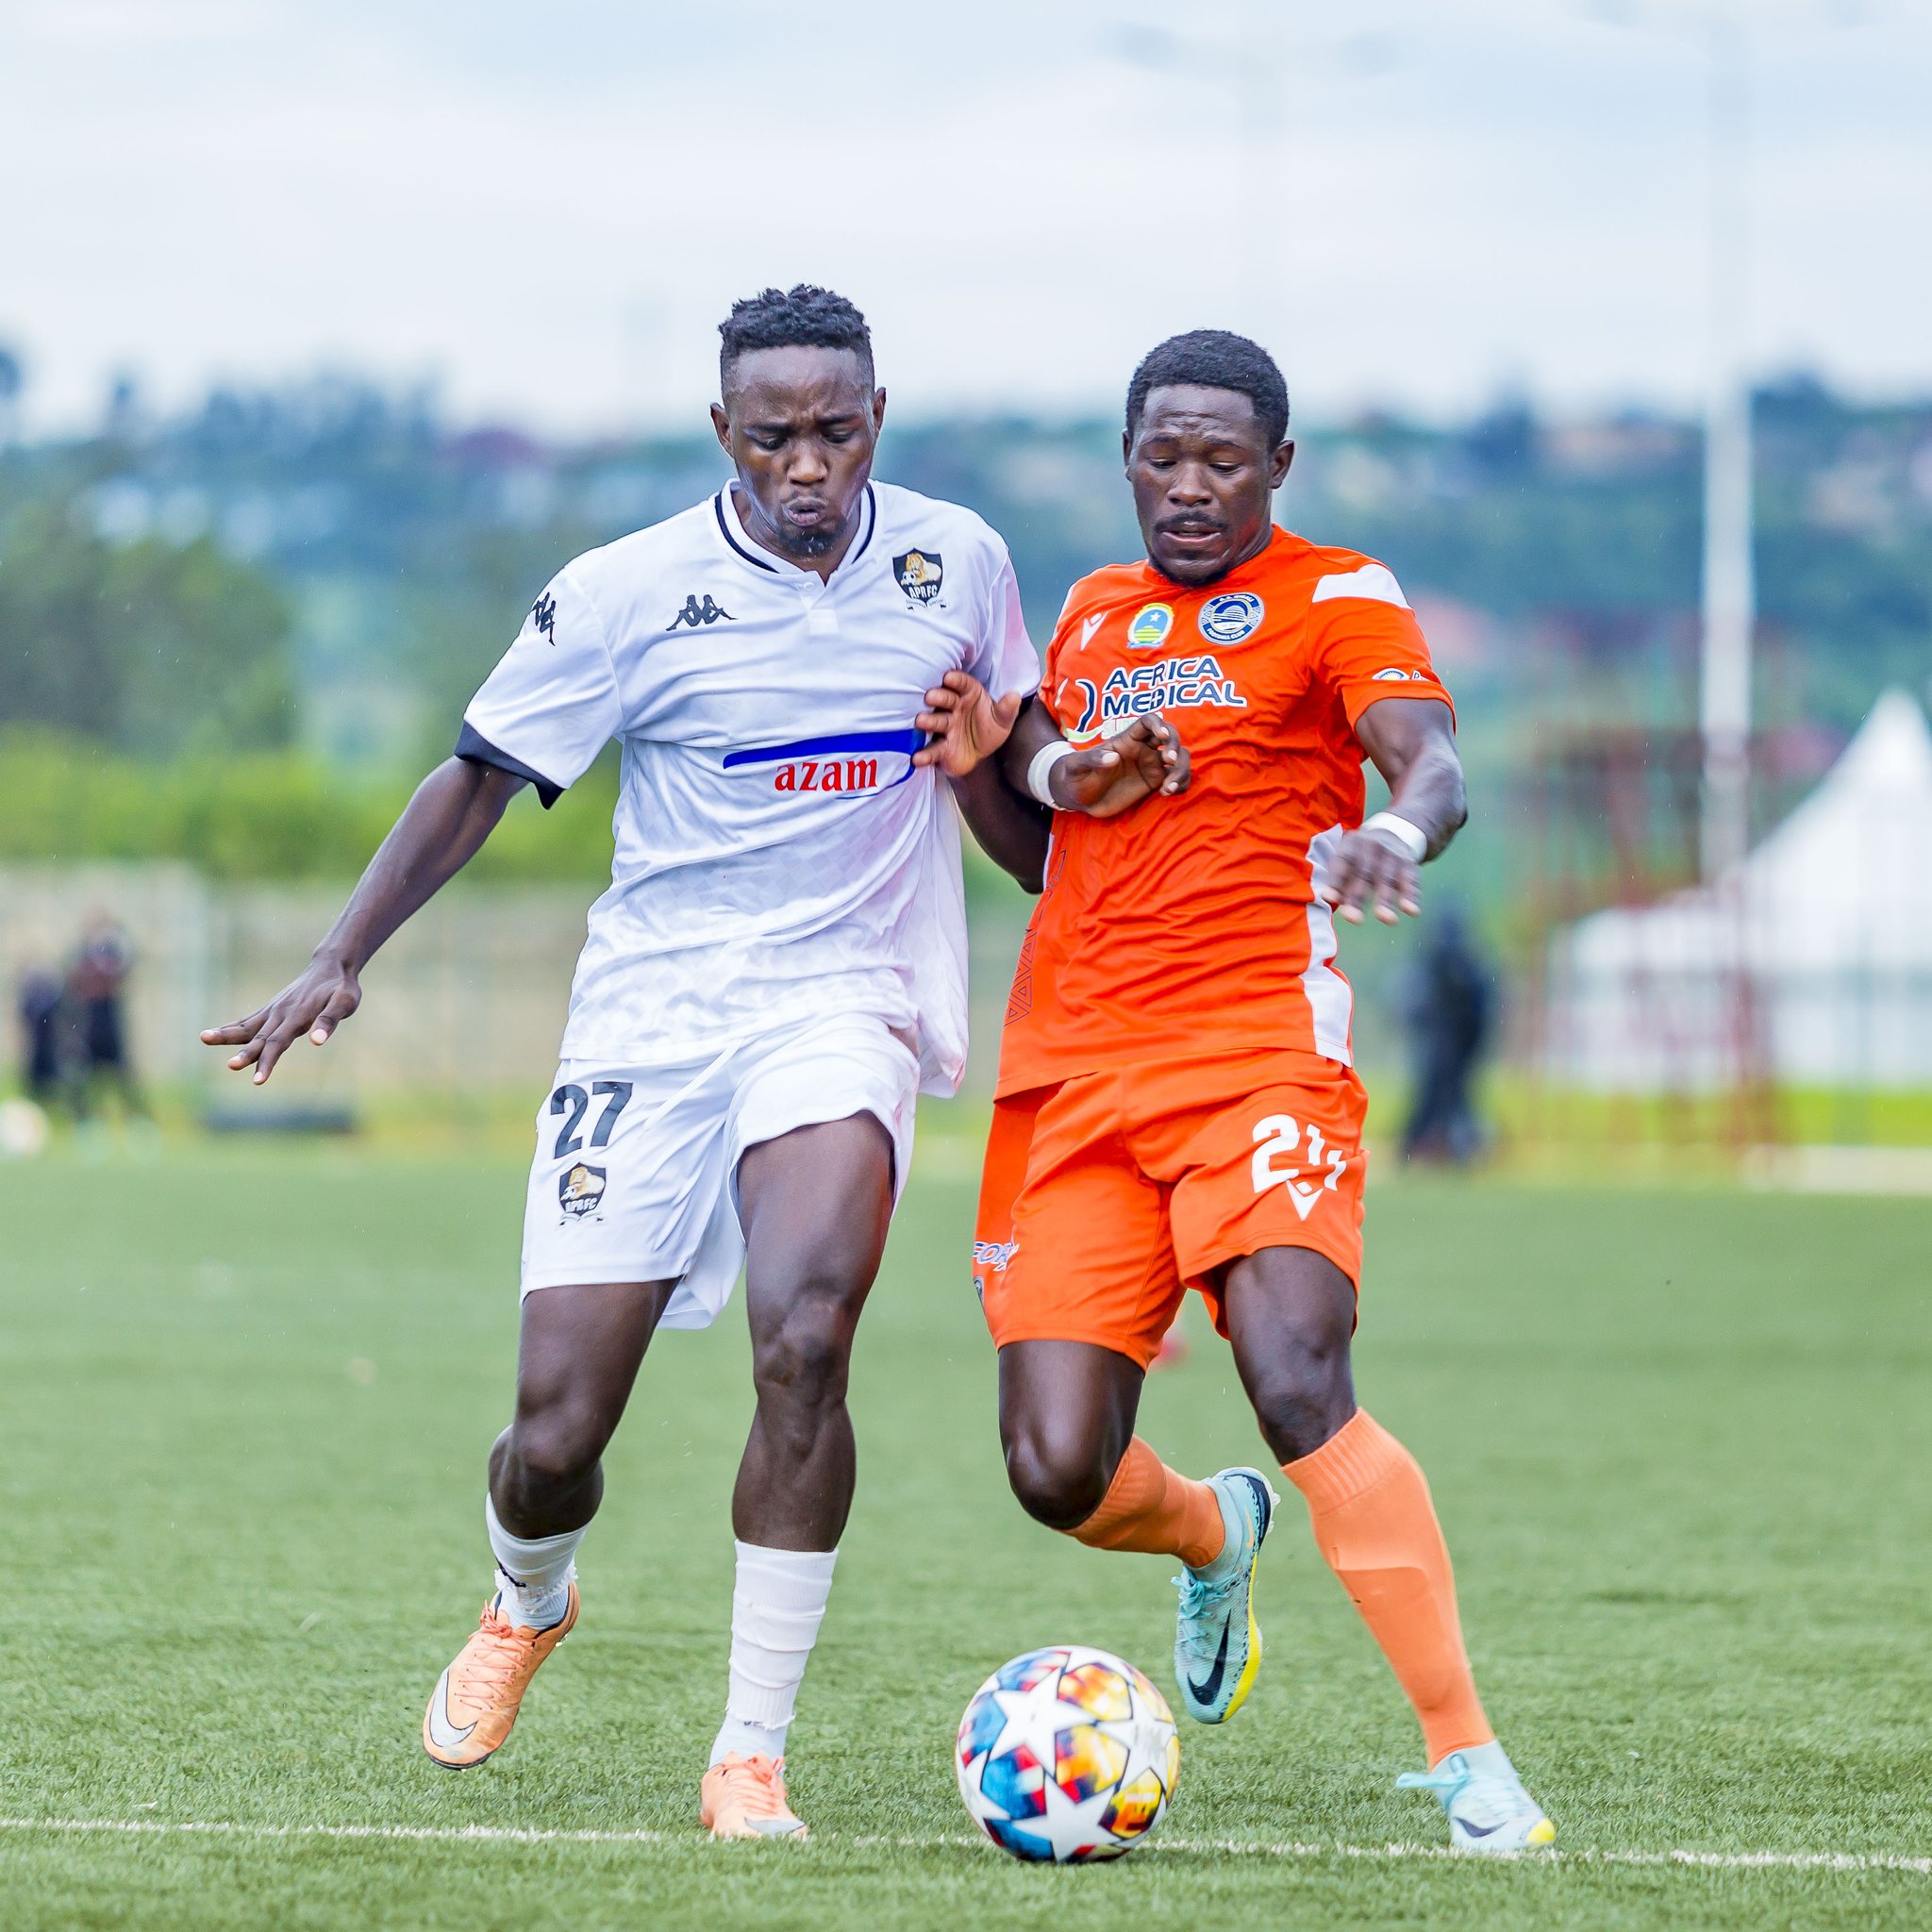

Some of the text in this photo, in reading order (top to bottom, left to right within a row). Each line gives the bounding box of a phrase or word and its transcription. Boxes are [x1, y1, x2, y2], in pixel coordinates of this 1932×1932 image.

[1104, 657, 1222, 691] AFRICA
[1103, 682, 1245, 718] MEDICAL
[774, 758, 878, 792] azam
[550, 1081, 633, 1159] 27
